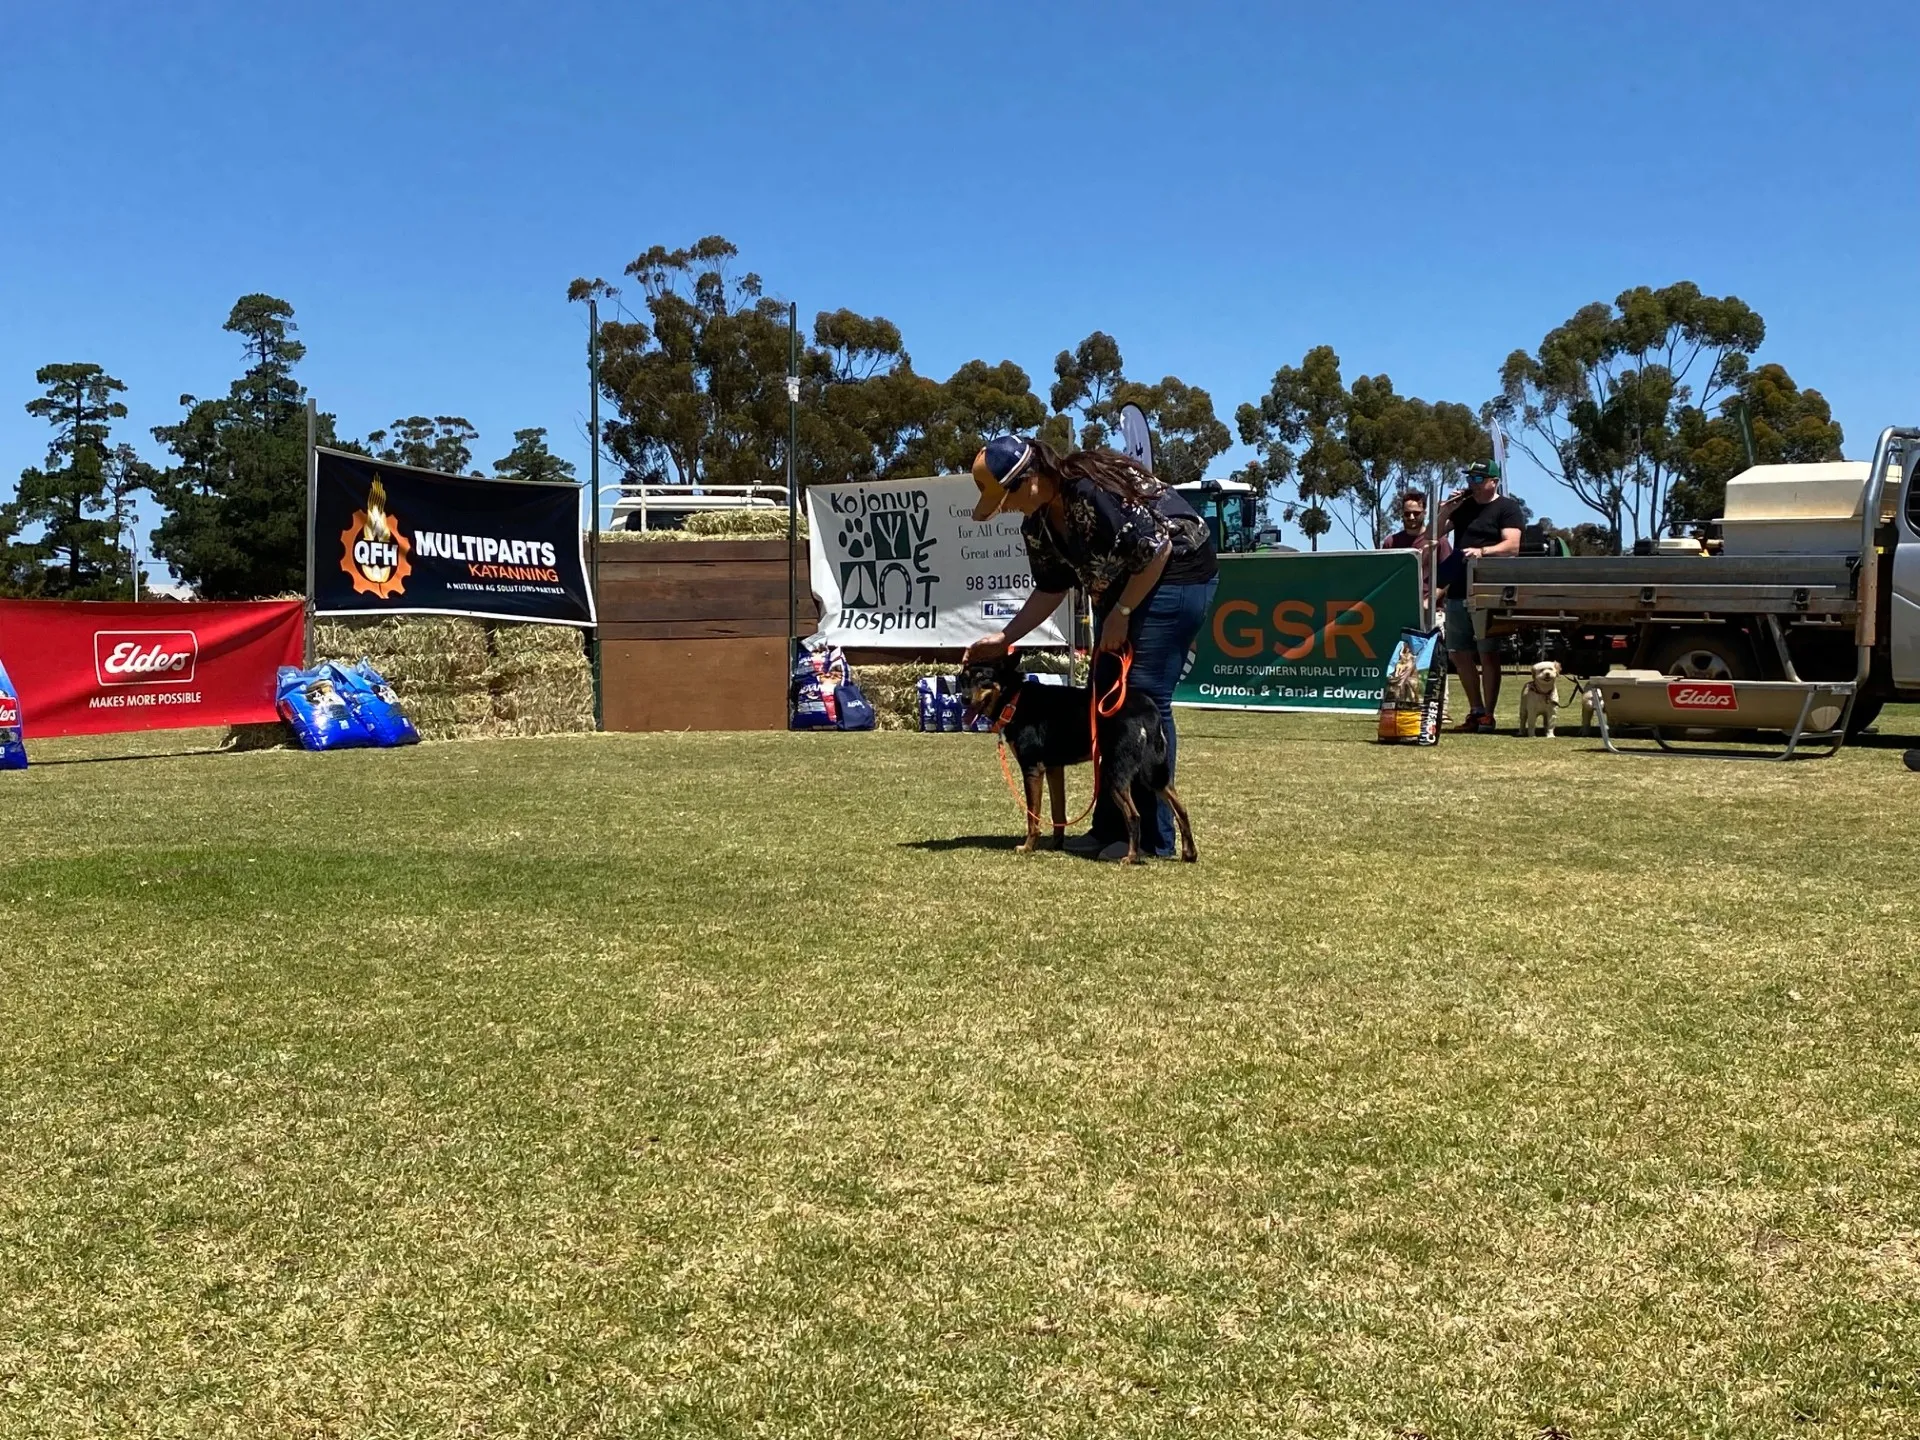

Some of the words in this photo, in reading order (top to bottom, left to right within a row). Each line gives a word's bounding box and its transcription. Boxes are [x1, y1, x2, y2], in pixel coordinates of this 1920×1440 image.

[831, 488, 928, 518] Kojonup
[958, 524, 974, 539] for
[977, 523, 993, 538] All
[354, 540, 398, 567] QFH
[414, 530, 557, 567] MULTIPARTS
[909, 508, 940, 608] VET
[960, 545, 989, 560] Great
[993, 544, 1011, 559] and
[468, 563, 560, 583] KATANNING
[446, 582, 452, 590] A
[453, 583, 485, 592] NUTRIEN
[485, 584, 496, 592] AG
[497, 584, 536, 593] SOLUTIONS
[966, 575, 984, 591] 98
[837, 605, 938, 635] Hospital
[1212, 599, 1377, 660] GSR
[104, 642, 191, 674] Elders
[1213, 664, 1244, 676] GREAT
[1246, 665, 1298, 677] SOUTHERN
[1300, 666, 1336, 677] RURAL
[1338, 666, 1359, 678] PTY
[1361, 667, 1380, 678] LTD
[89, 695, 125, 709] MAKES
[126, 693, 157, 707] MORE
[158, 691, 202, 705] POSSIBLE
[1199, 683, 1256, 698] Clynton
[1260, 684, 1271, 697] &
[1277, 684, 1318, 699] Tania
[1675, 688, 1731, 705] Elders
